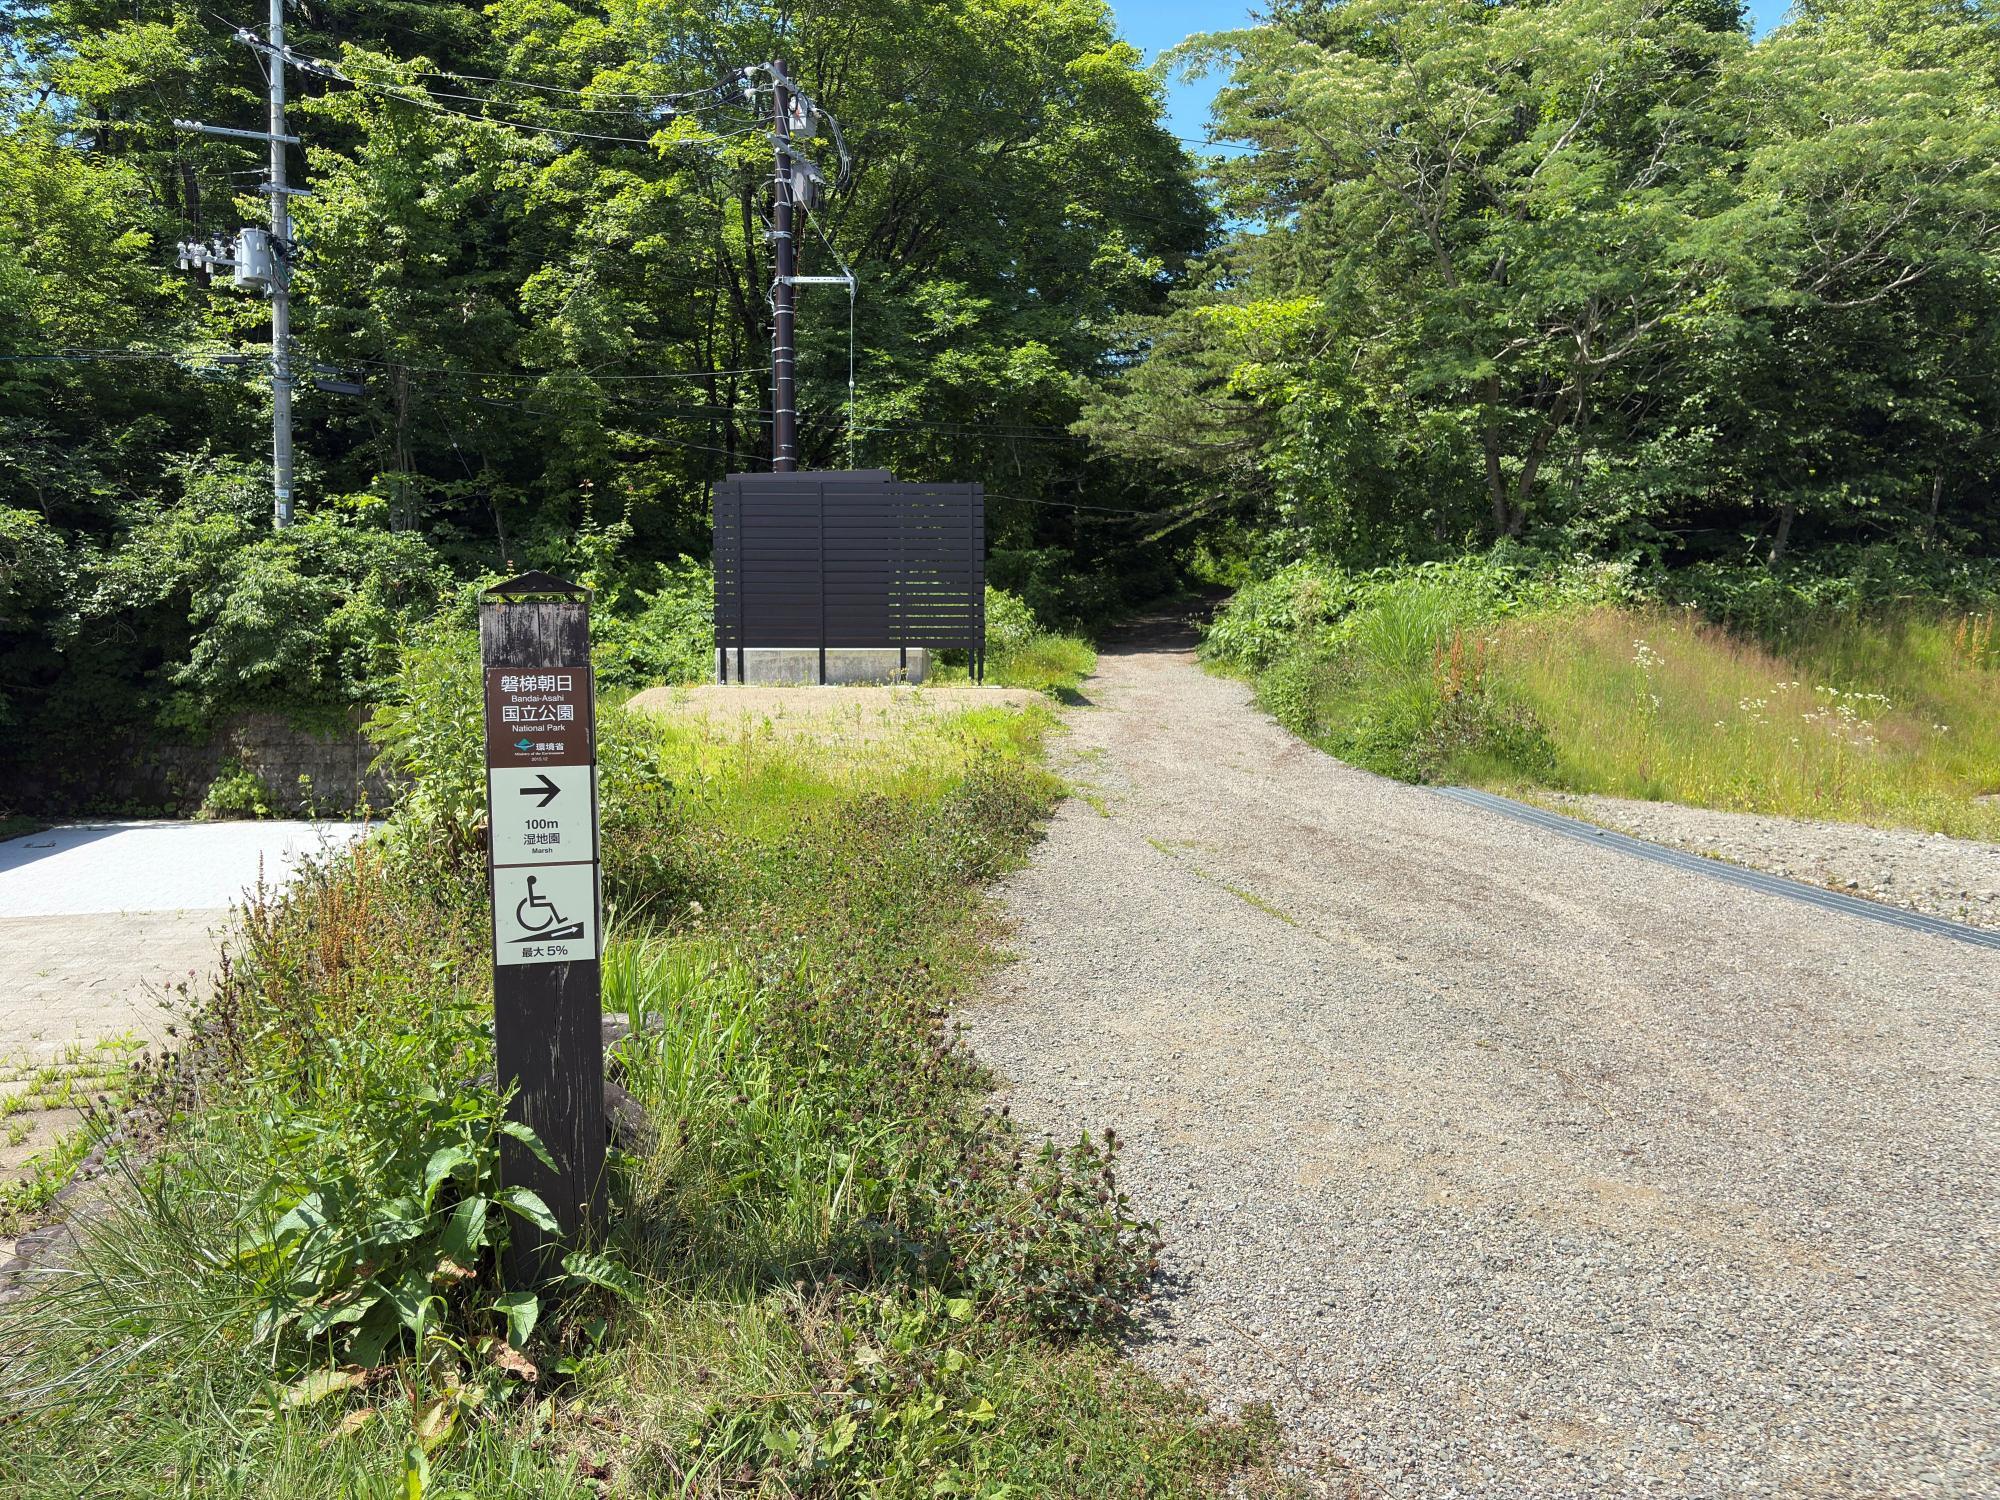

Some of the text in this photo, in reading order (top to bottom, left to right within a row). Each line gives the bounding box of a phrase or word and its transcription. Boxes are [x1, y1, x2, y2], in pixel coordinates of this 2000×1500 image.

[501, 675, 572, 692] 磐梯朝日
[511, 694, 565, 703] Bandai-Asahi
[502, 705, 574, 722] 国立公園
[512, 723, 566, 732] National Park
[535, 742, 564, 751] 環境省
[524, 819, 559, 830] 100m
[524, 833, 560, 845] 湿地園
[522, 945, 568, 958] 最大 5%
